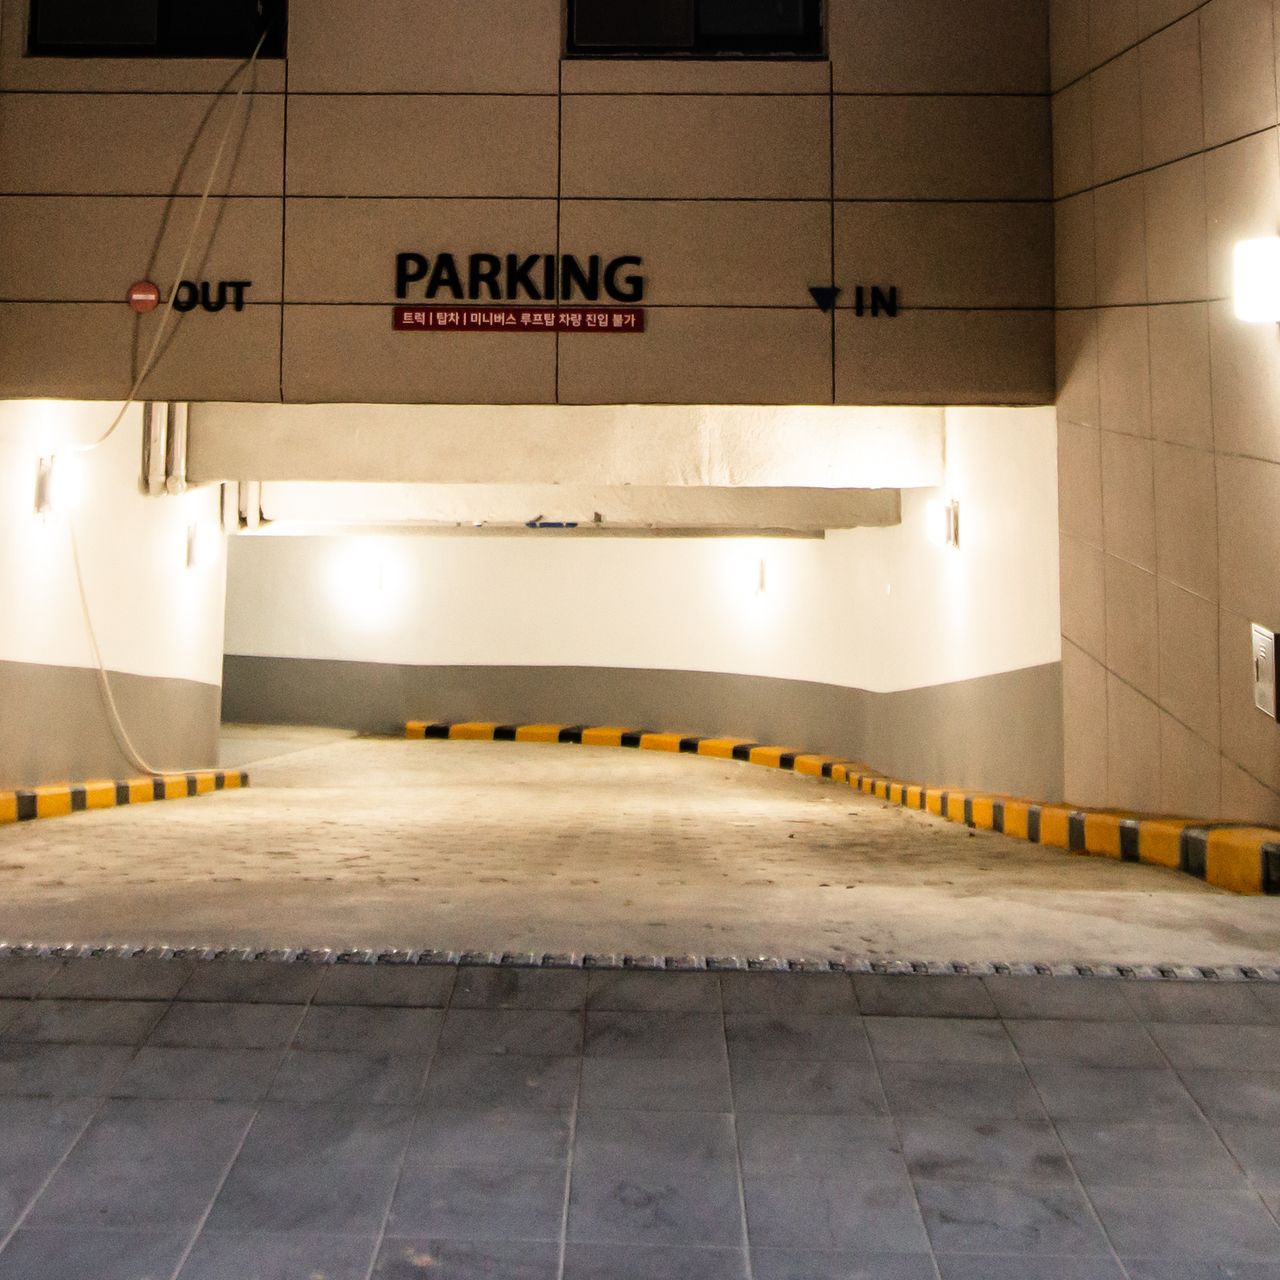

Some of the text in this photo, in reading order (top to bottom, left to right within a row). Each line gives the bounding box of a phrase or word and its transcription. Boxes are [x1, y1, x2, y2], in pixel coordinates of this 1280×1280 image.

[395, 253, 644, 302] PARKING
[170, 280, 252, 313] OUT
[855, 286, 898, 318] IN
[402, 312, 636, 328] 트럭 탑차 미니버스 루프탑 차량 진입 불가
